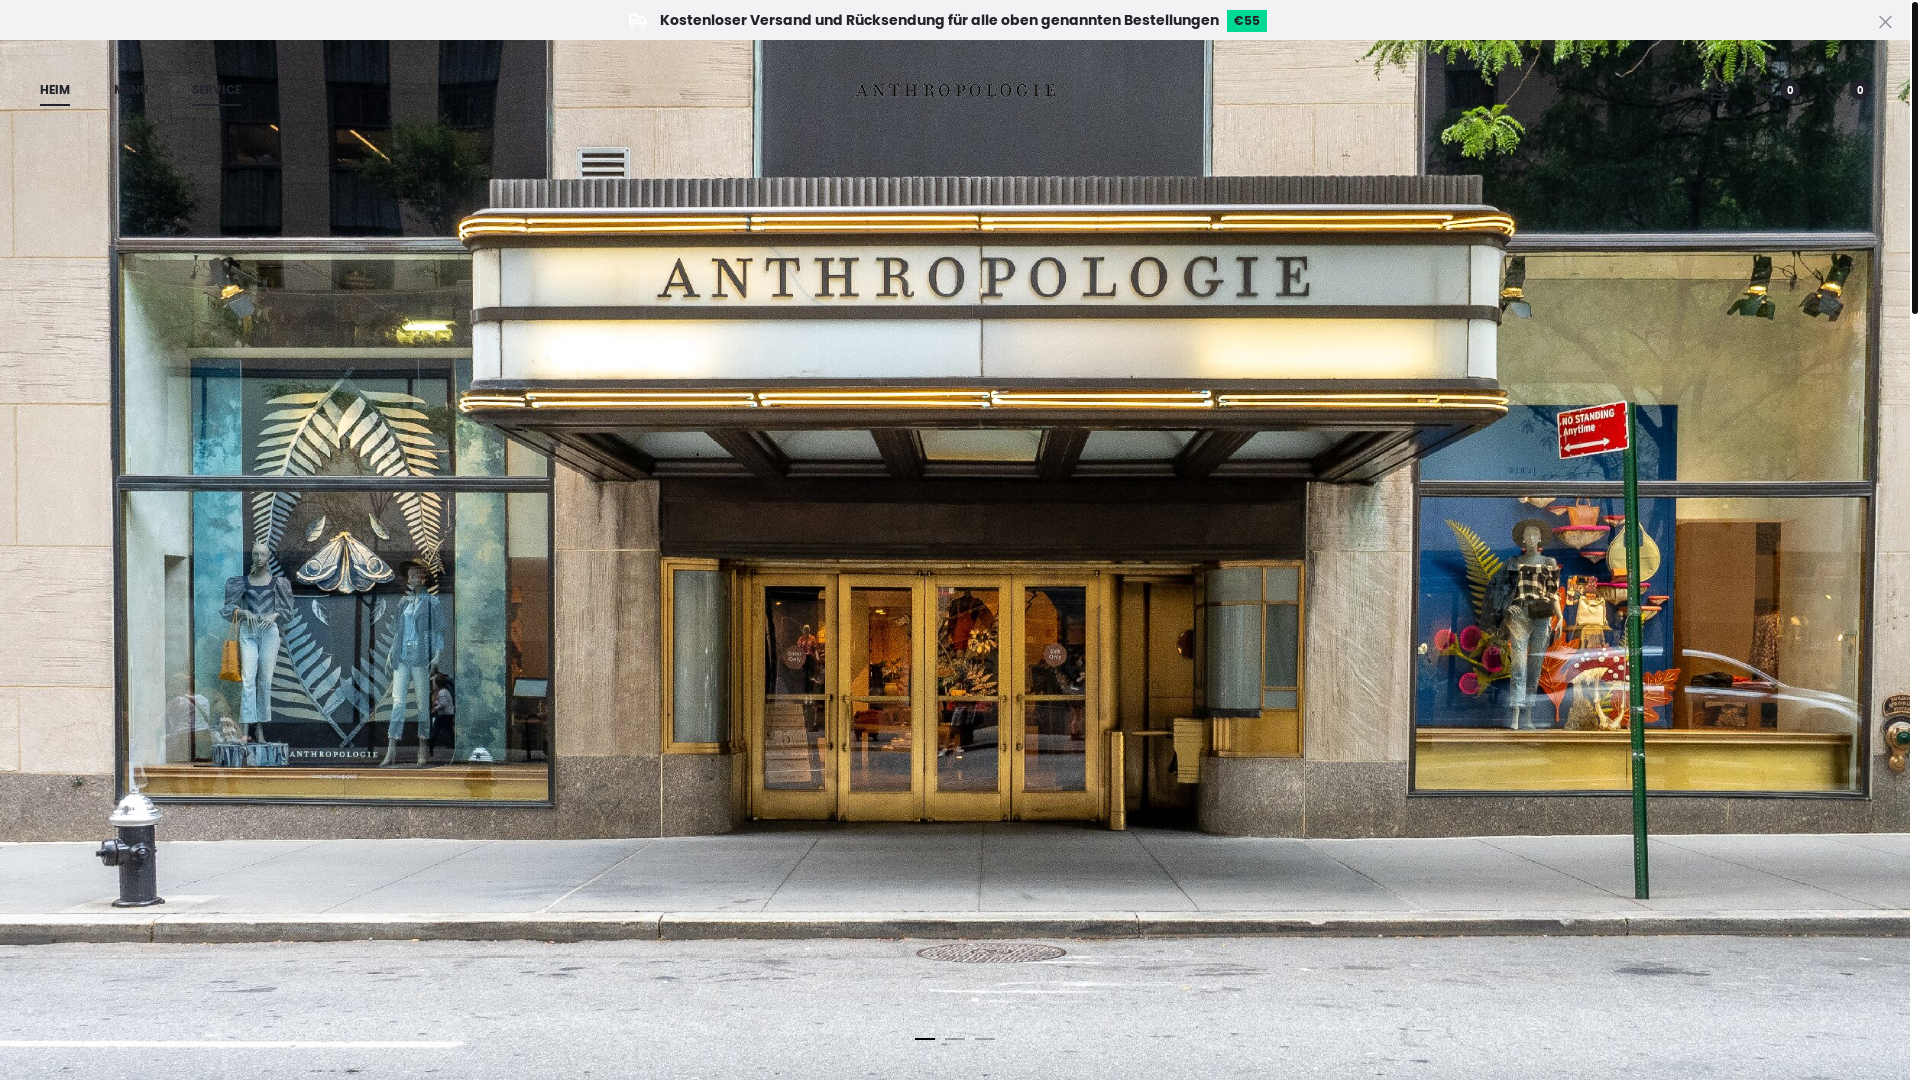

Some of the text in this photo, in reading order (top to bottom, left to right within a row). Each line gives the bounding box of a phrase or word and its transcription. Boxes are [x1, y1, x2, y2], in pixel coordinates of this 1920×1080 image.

[657, 256, 1311, 299] ANTHROPOLOGIE
[1562, 408, 1615, 426] NO STANDING
[1563, 424, 1596, 436] Anytime
[289, 750, 379, 759] ANTHROPOLOGIE
